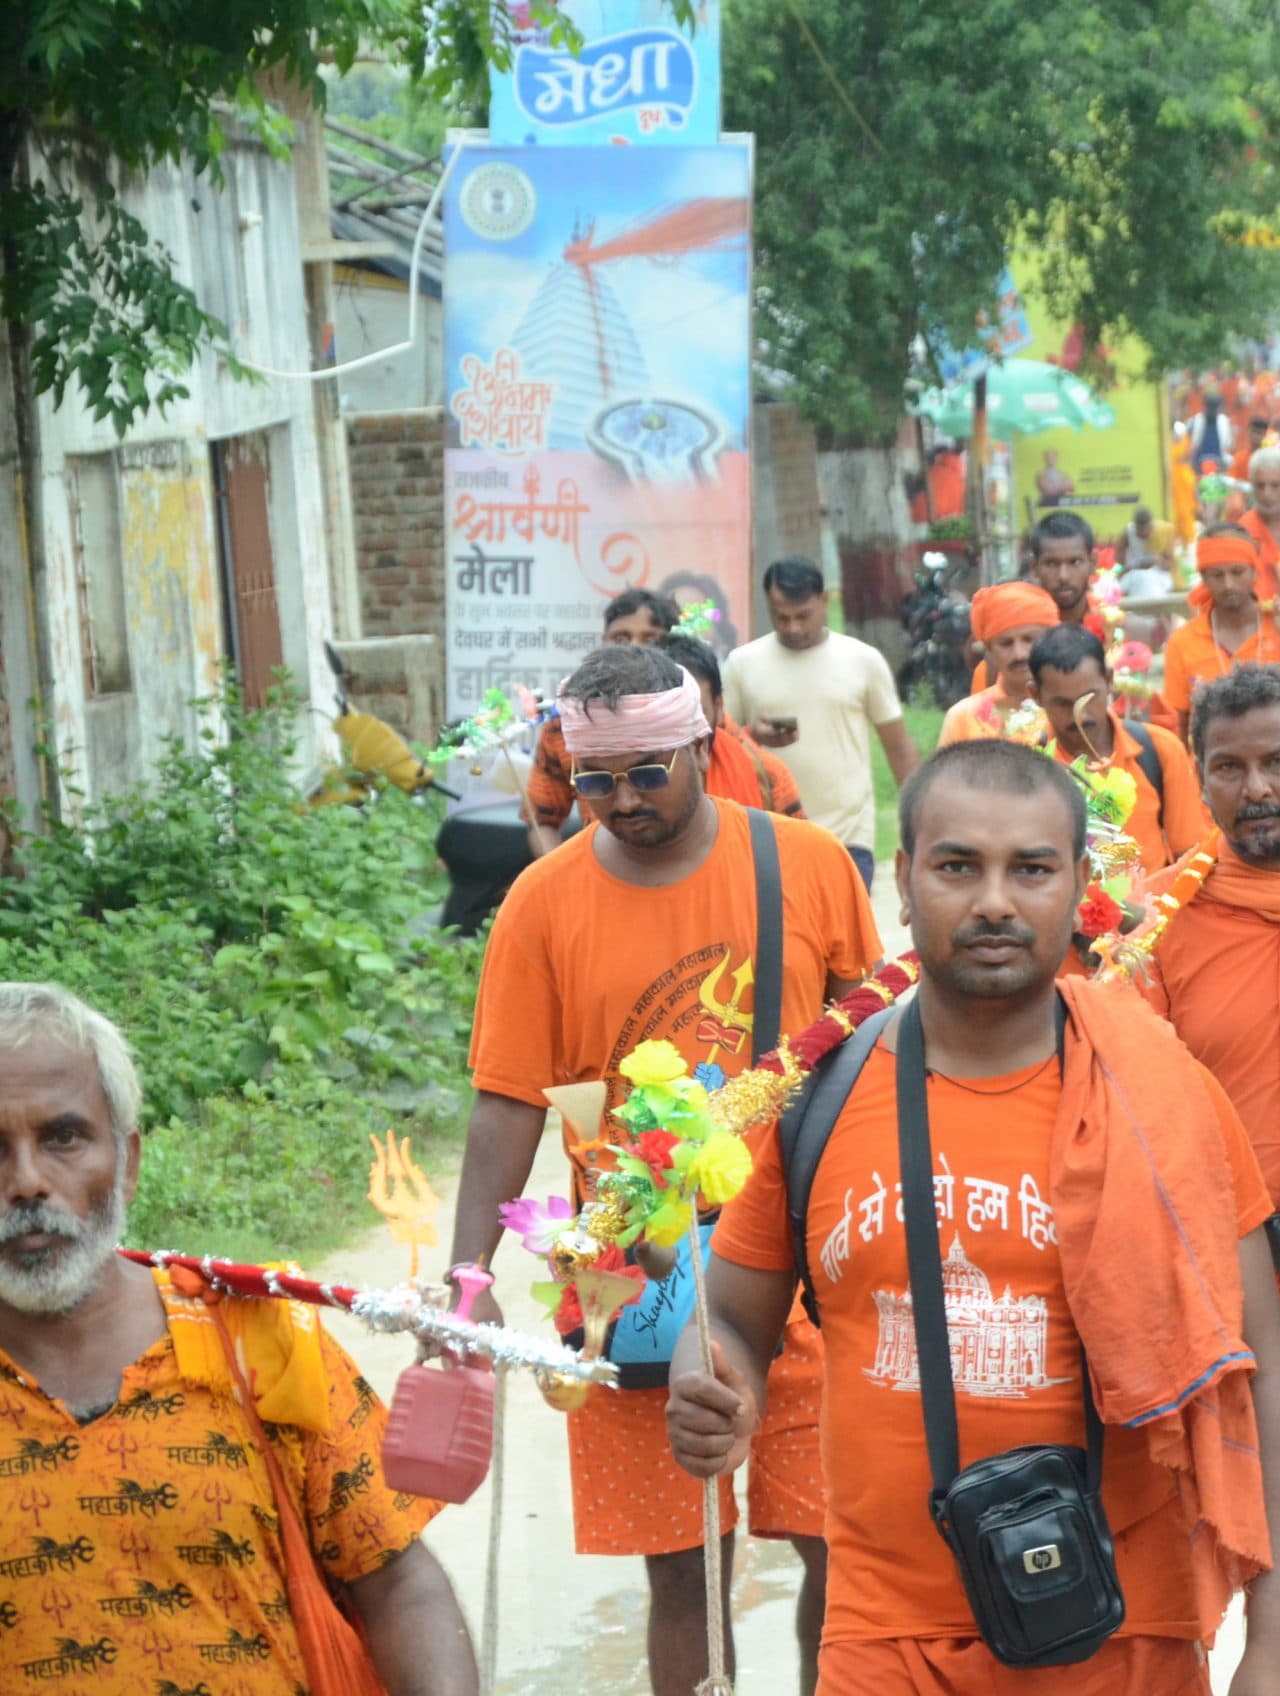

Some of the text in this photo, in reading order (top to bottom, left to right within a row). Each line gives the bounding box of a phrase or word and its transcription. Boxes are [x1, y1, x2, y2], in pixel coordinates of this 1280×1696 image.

[533, 41, 677, 114] मेधा
[452, 472, 590, 545] श्रावणी
[453, 541, 534, 595] मेला
[819, 1188, 853, 1284] गर्व
[858, 1171, 887, 1242] से
[964, 1176, 1010, 1232] हम
